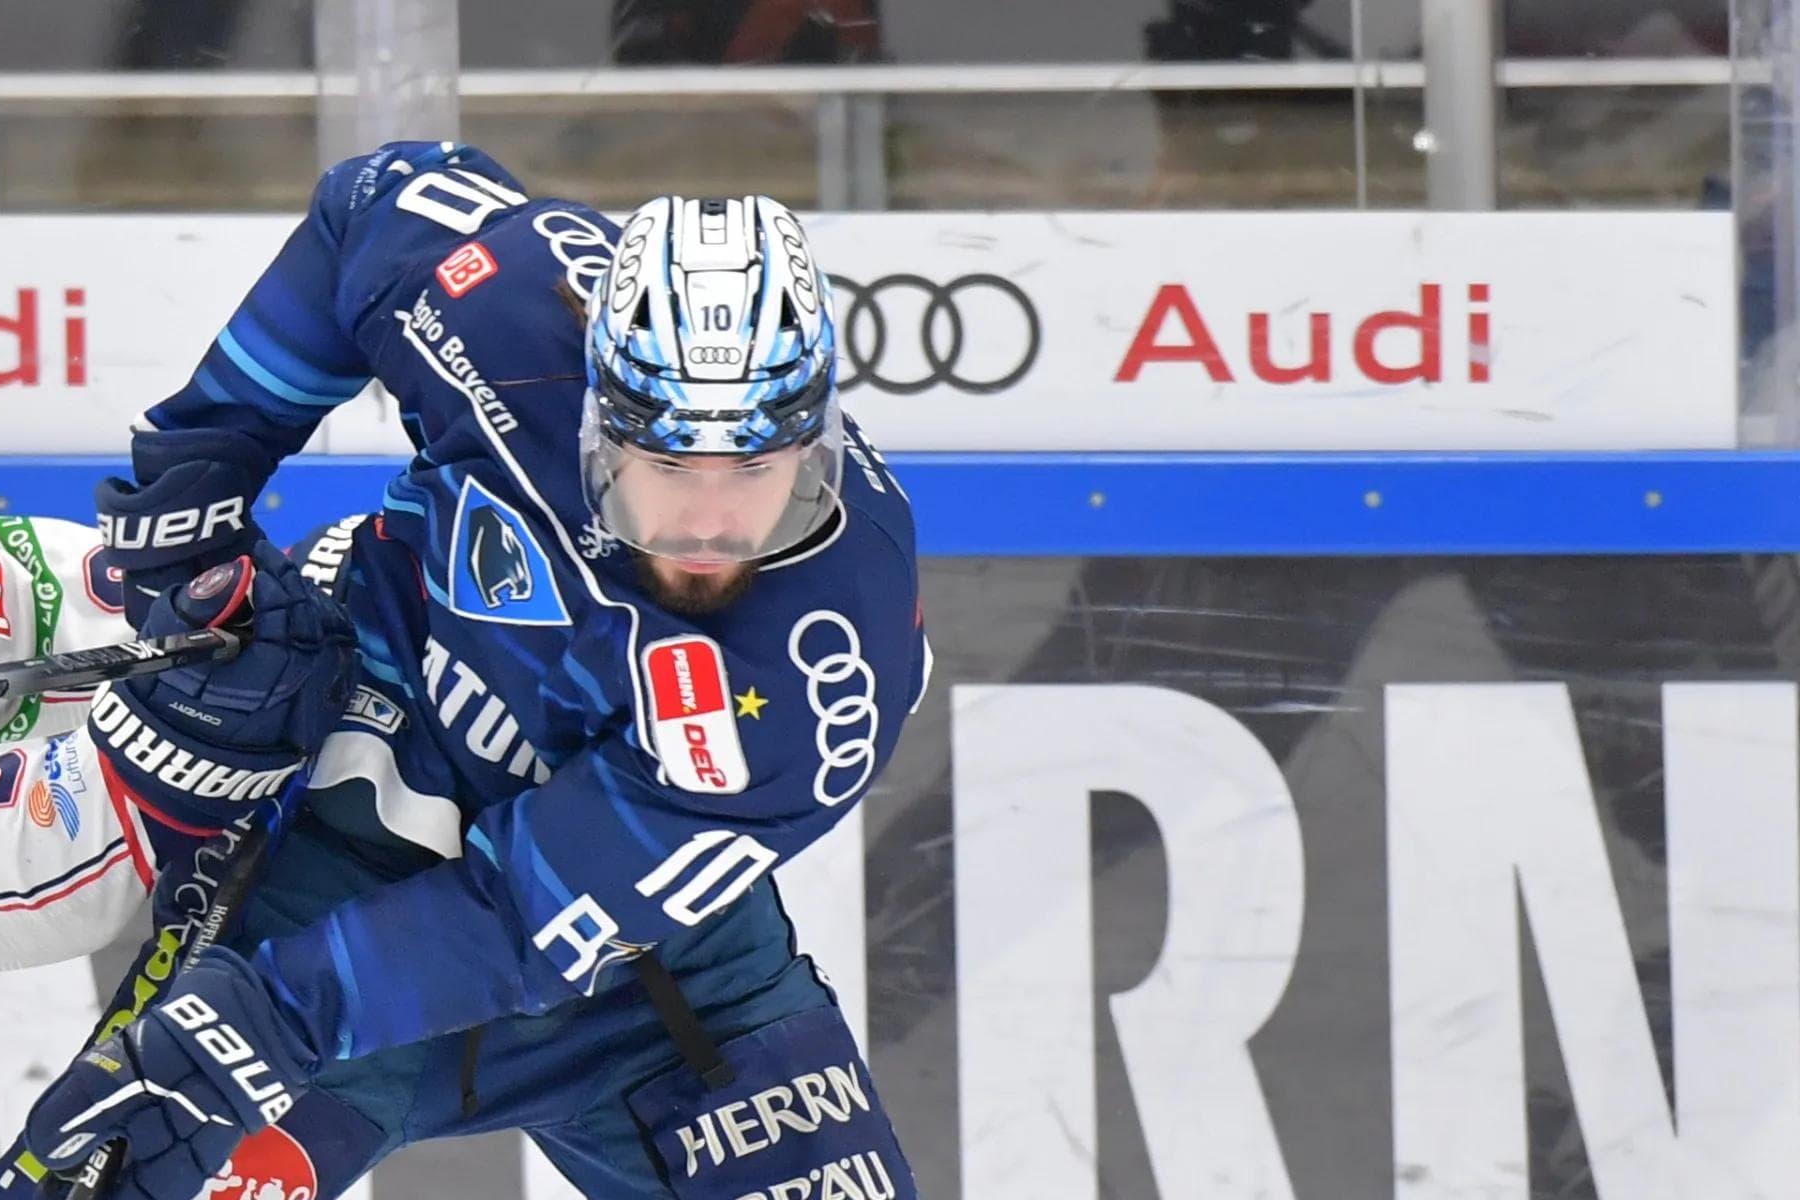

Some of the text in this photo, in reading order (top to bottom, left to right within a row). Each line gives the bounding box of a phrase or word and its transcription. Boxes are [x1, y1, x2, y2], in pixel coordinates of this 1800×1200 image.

[442, 250, 485, 293] DB
[699, 303, 732, 331] 10
[1112, 284, 1491, 384] Audi
[438, 336, 519, 434] Bayern
[91, 679, 308, 801] WARRIO
[168, 700, 223, 727] COVERT
[635, 830, 779, 926] 10
[675, 1062, 871, 1179] HERRN
